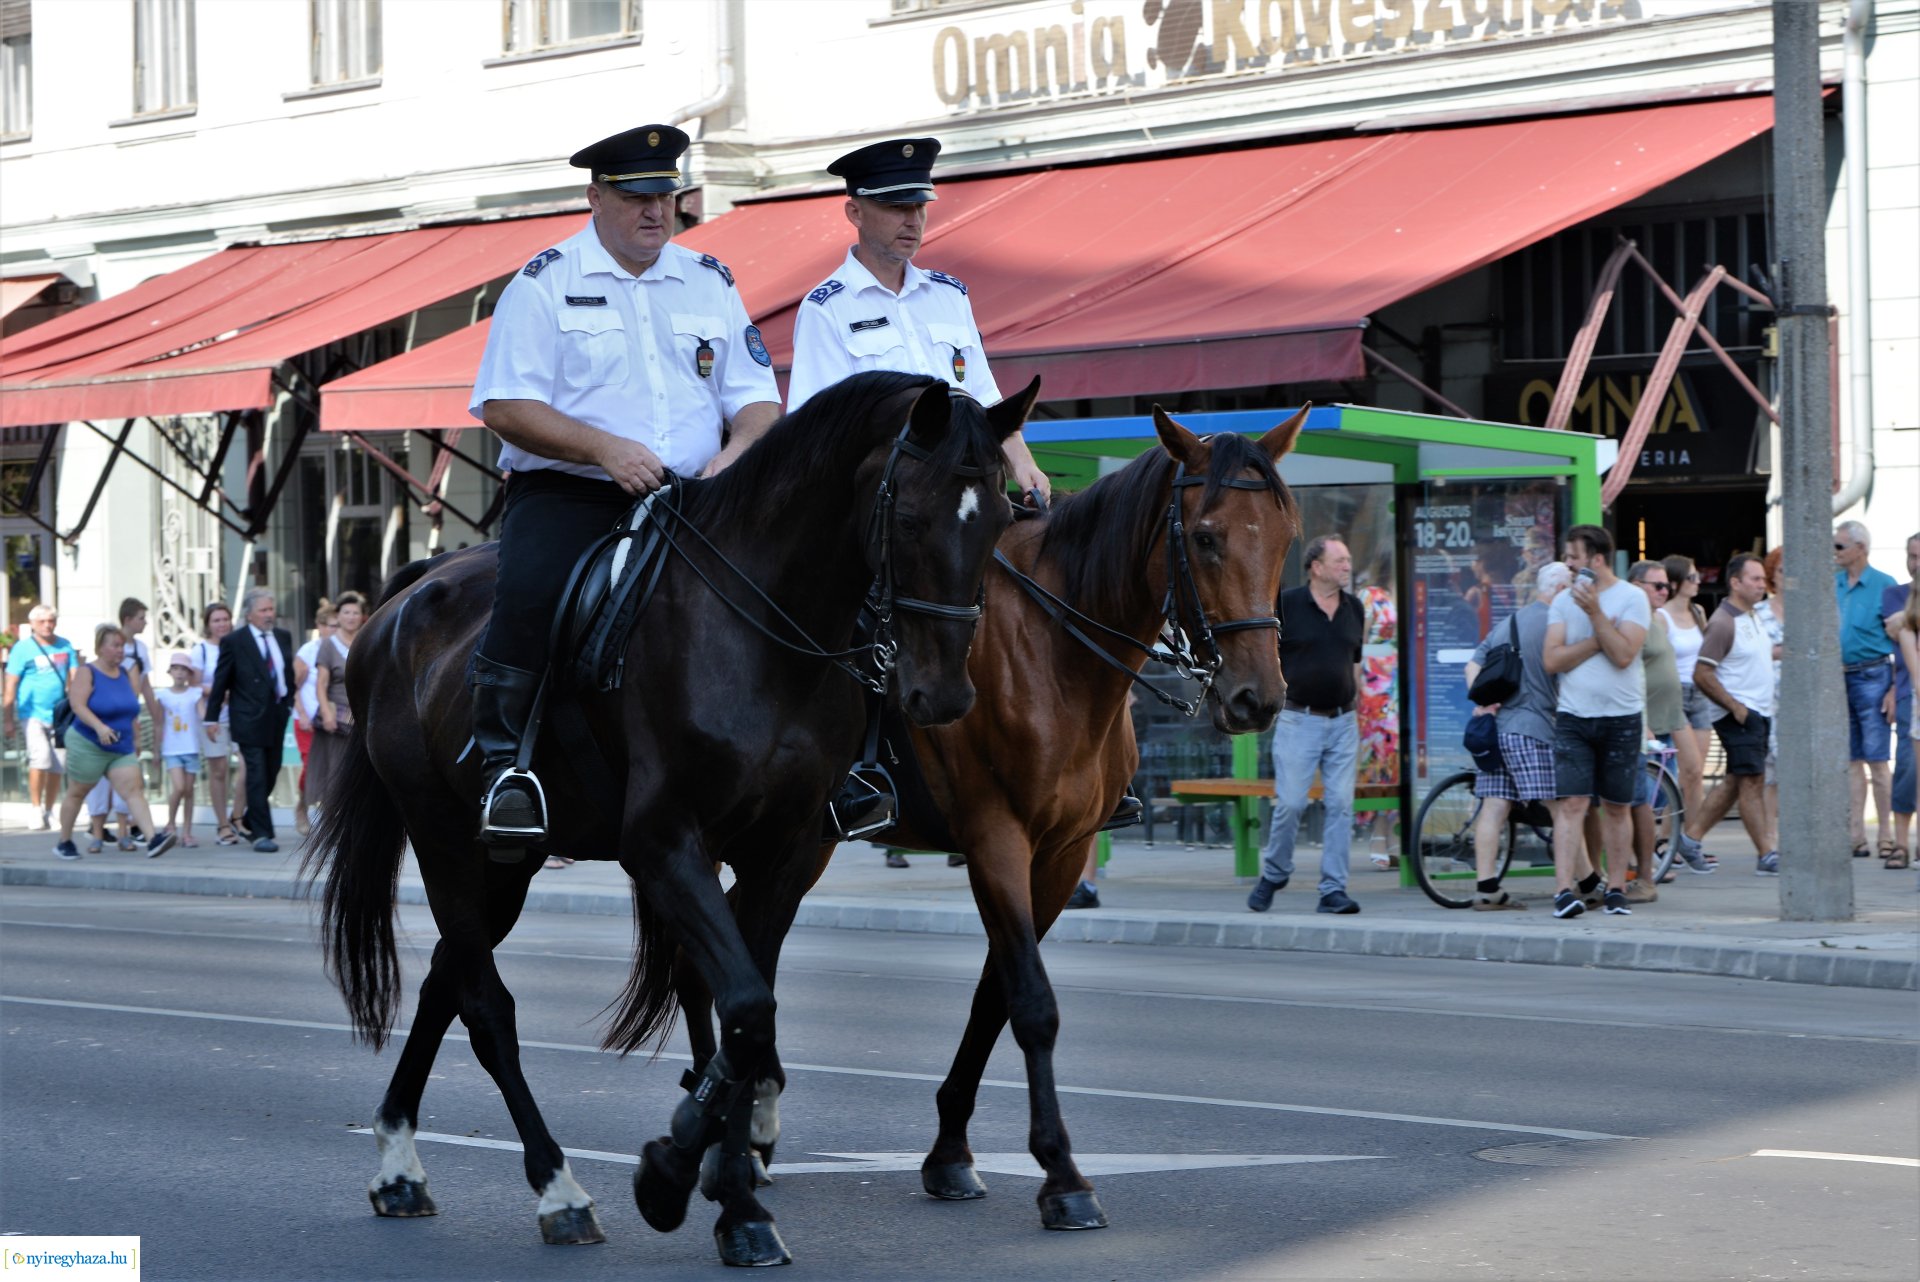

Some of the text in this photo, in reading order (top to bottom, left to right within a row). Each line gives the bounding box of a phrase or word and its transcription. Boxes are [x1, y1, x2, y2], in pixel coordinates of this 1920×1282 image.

[933, 3, 1128, 105] Omnia
[1519, 373, 1701, 434] OMNA
[1414, 505, 1471, 518] AUGUSZTUS
[1414, 521, 1475, 548] 18-20.
